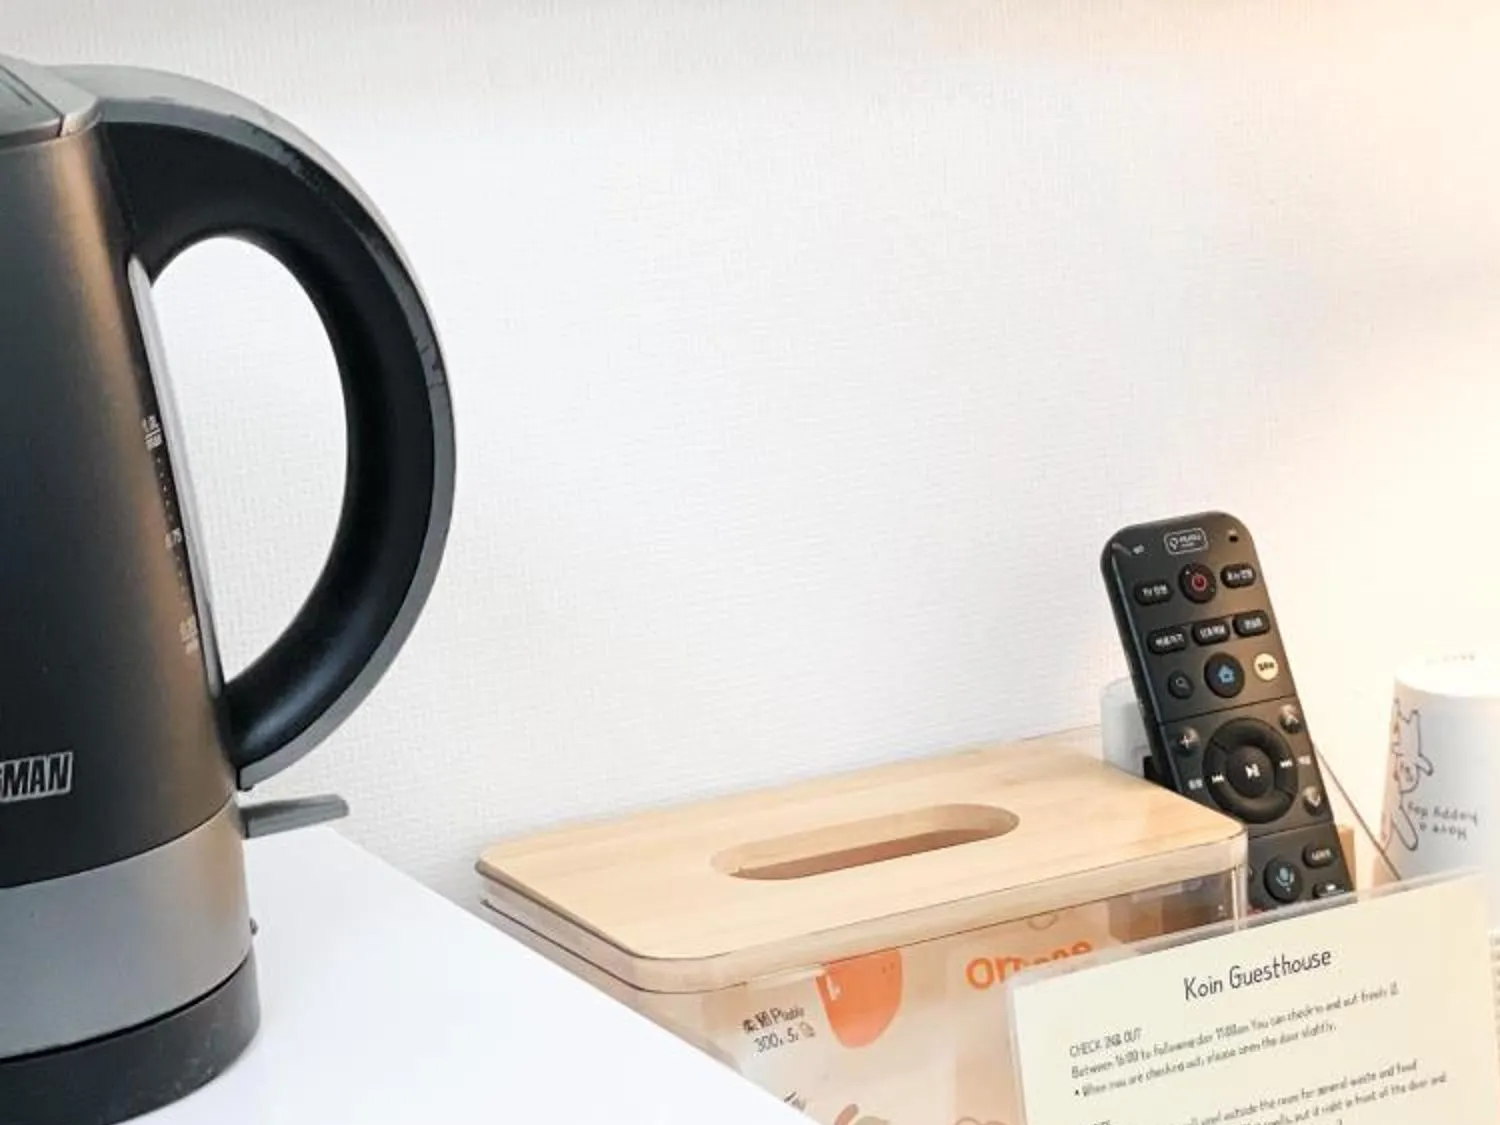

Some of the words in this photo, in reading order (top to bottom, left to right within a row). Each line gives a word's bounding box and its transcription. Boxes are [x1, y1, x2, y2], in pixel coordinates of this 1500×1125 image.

[0, 754, 71, 800] MAN
[1183, 968, 1223, 1001] Koin
[1228, 941, 1332, 990] Guesthouse
